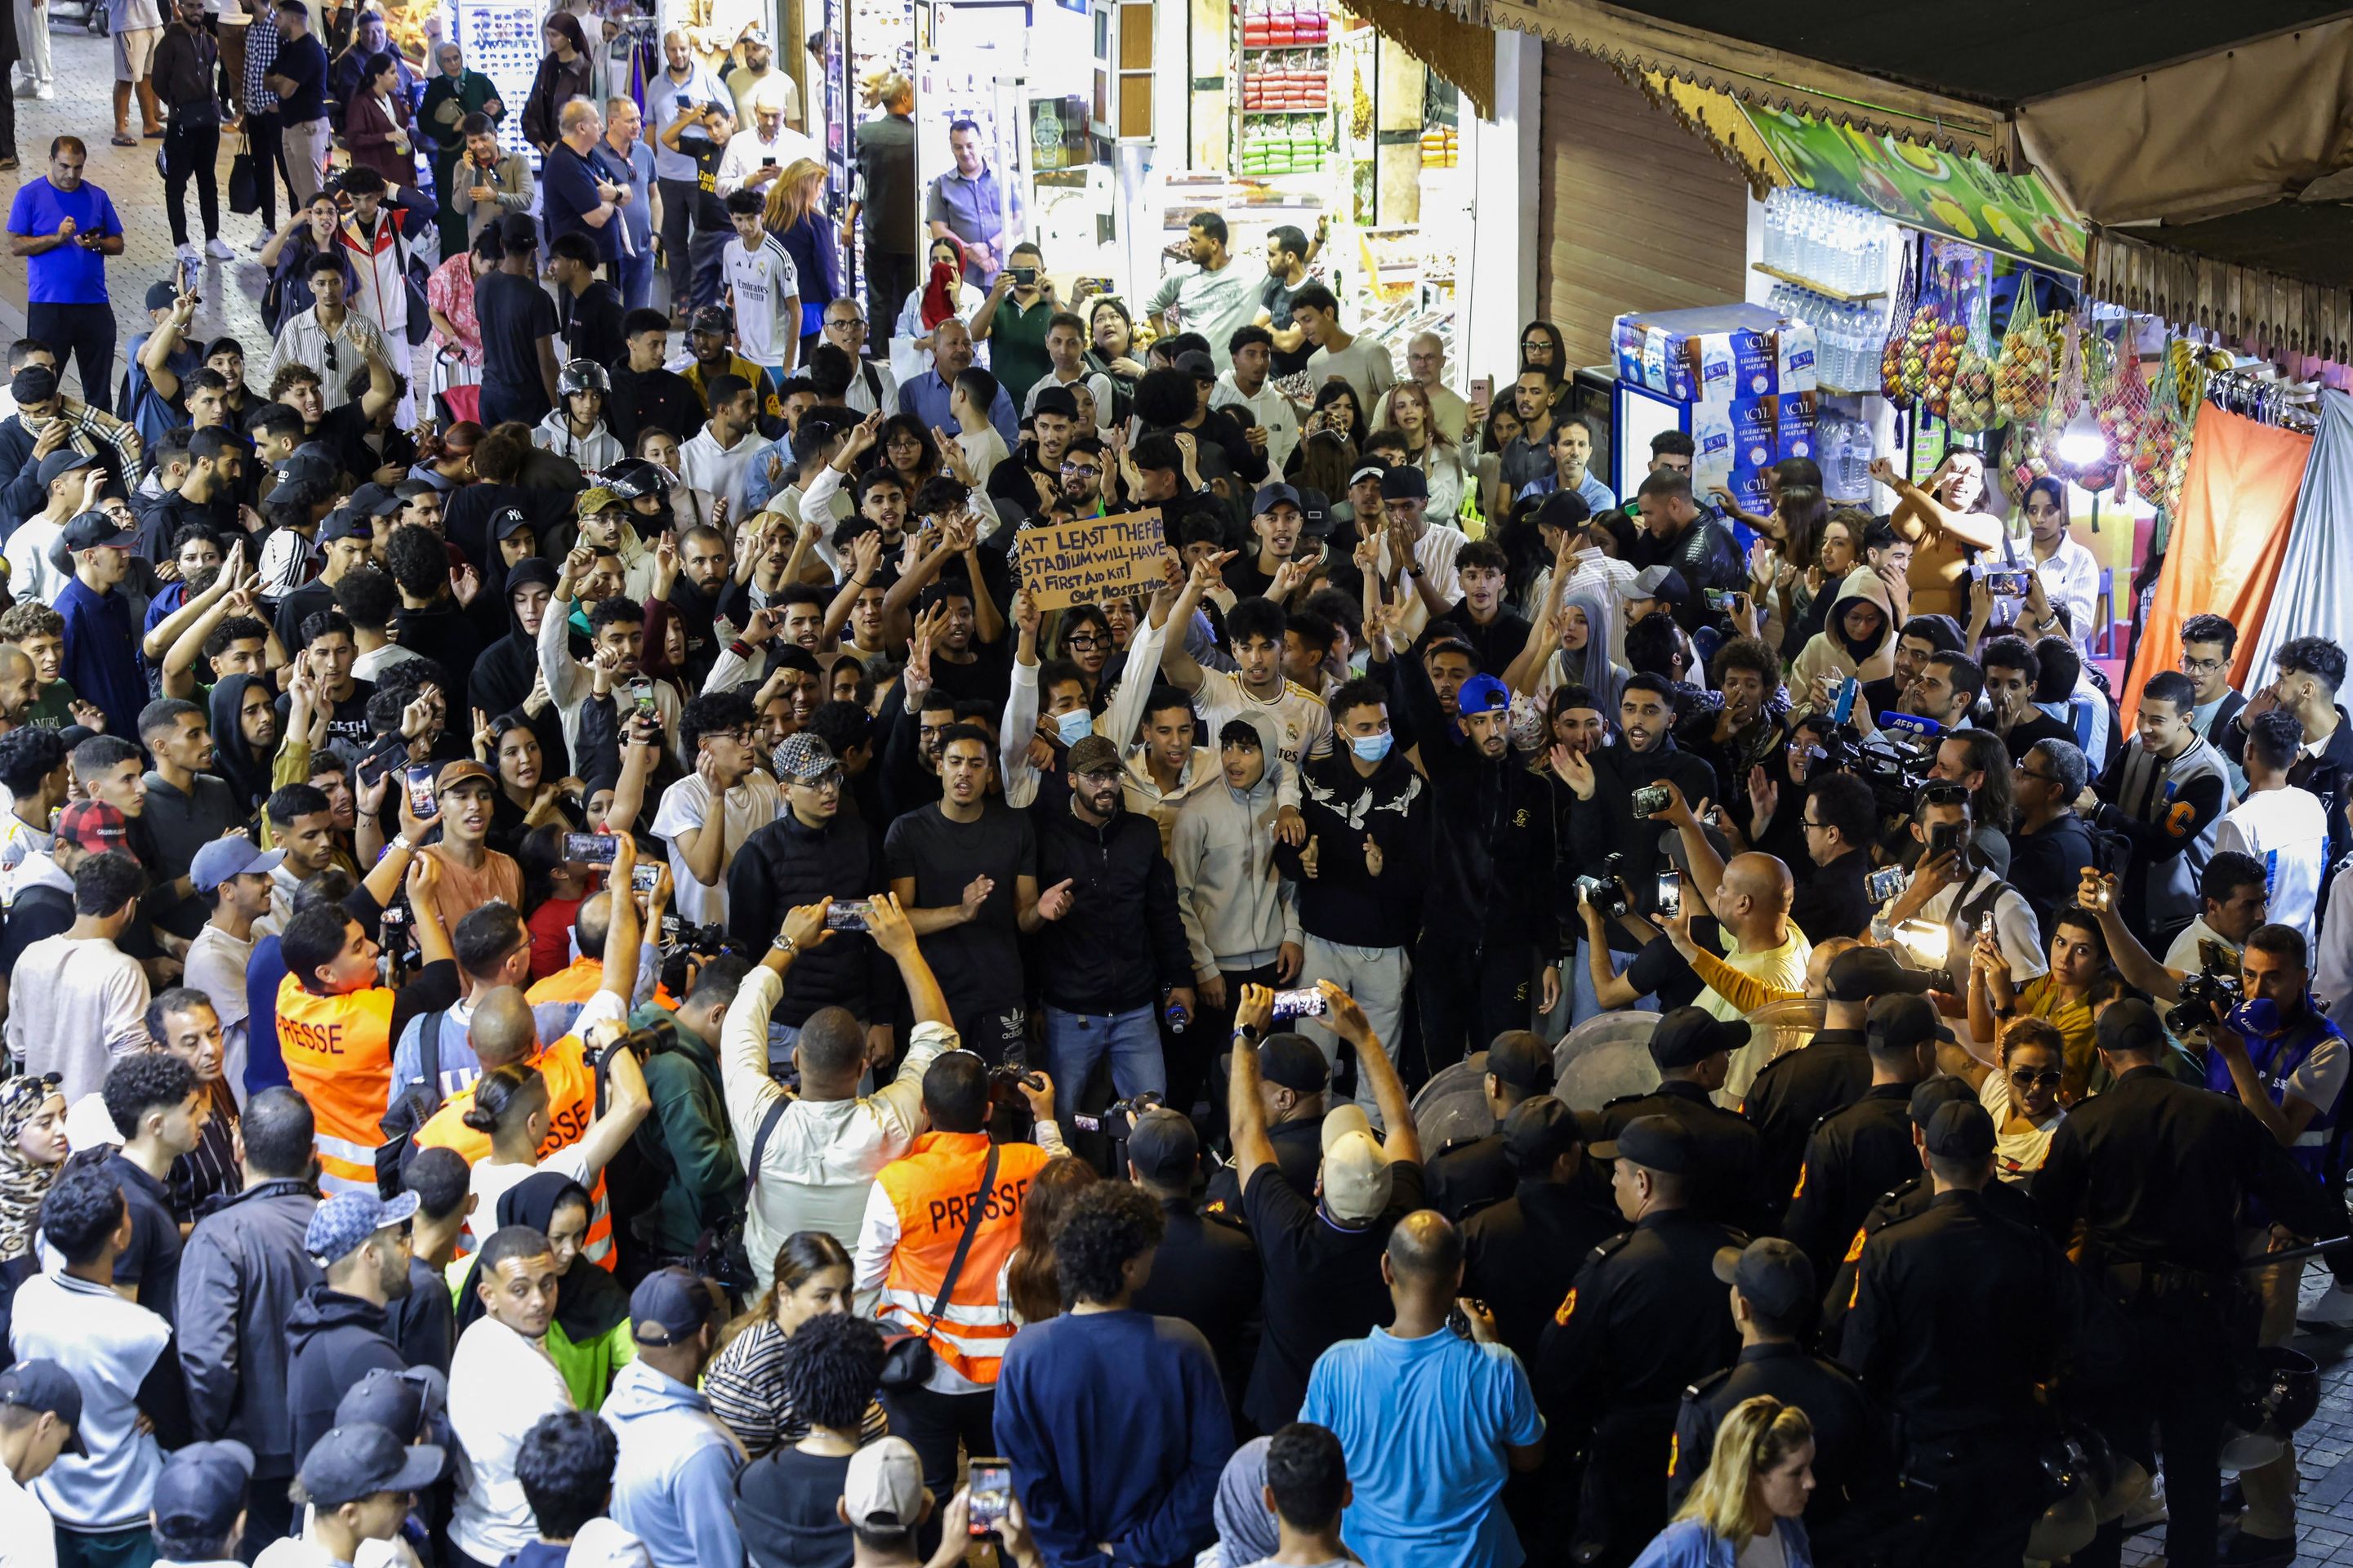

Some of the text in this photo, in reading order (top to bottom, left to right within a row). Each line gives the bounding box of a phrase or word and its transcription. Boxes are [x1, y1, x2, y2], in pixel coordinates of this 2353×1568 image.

[737, 278, 769, 294] Emirates
[1743, 336, 1771, 350] ACYL
[1793, 353, 1812, 364] ACYL
[1707, 364, 1727, 376] ACYL
[1742, 407, 1771, 421] ACYL
[1783, 401, 1812, 416] ACYL
[1706, 436, 1725, 448] ACYL
[1740, 479, 1769, 492] ACYL
[1021, 537, 1048, 555] AT
[1055, 525, 1109, 550] LEAST
[1094, 546, 1129, 563] WILL
[1130, 541, 1166, 561] HAVE
[1029, 577, 1042, 594] A
[1085, 571, 1105, 586] AID
[1892, 719, 1914, 729] AFP
[2165, 801, 2196, 837] C
[278, 1018, 345, 1054] RESSE
